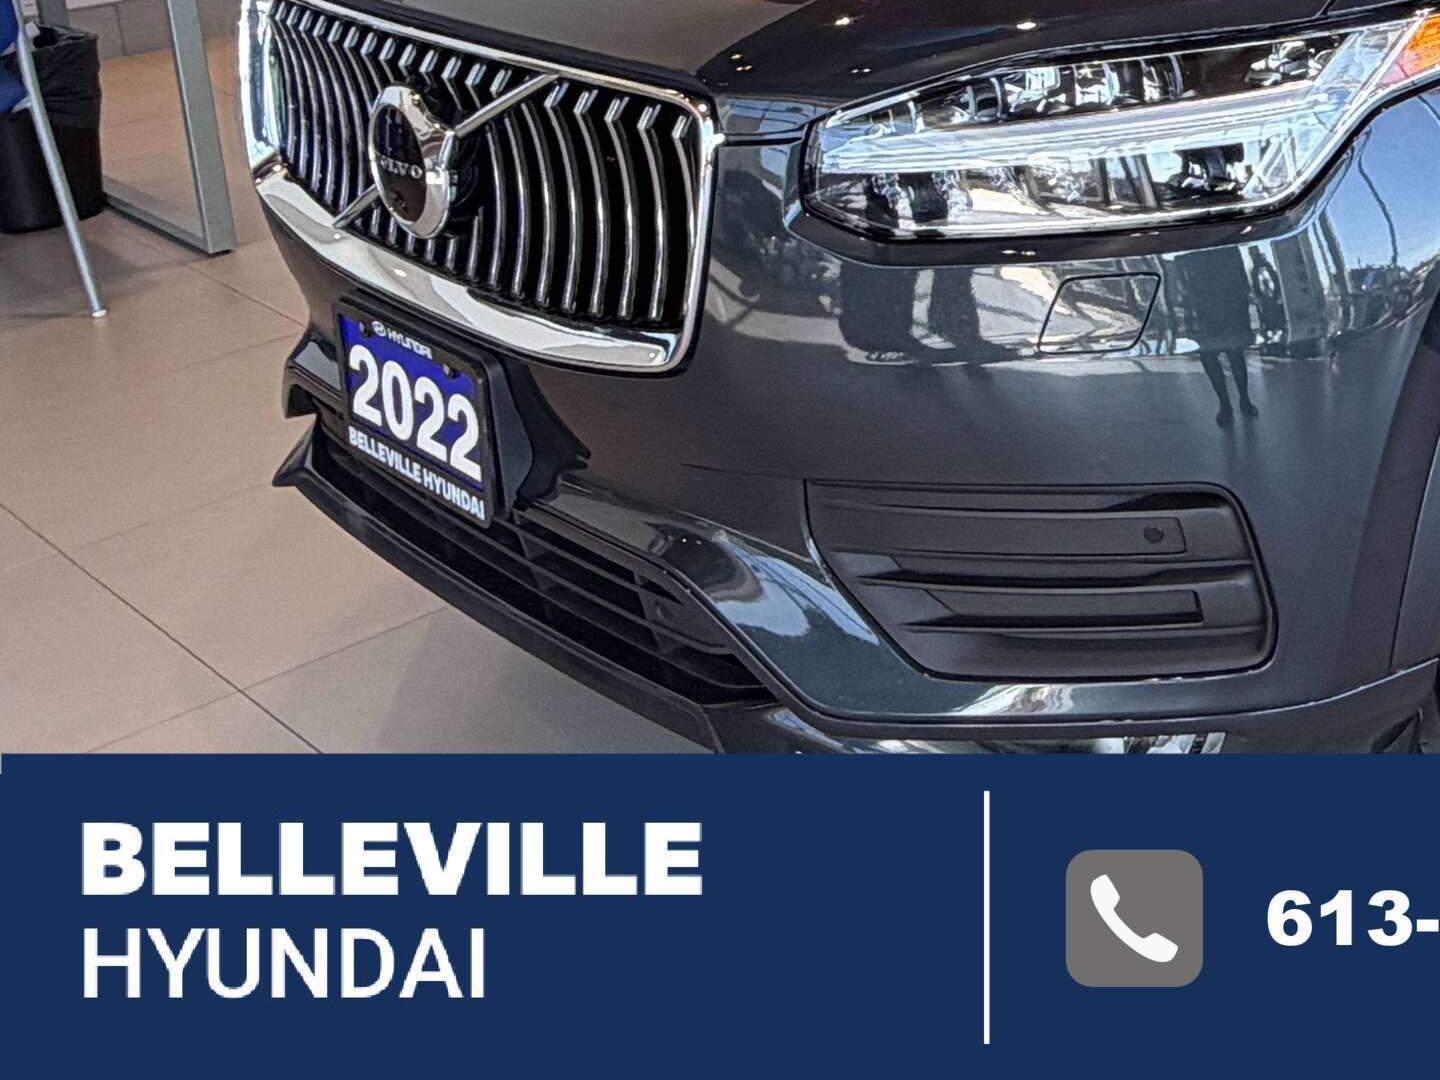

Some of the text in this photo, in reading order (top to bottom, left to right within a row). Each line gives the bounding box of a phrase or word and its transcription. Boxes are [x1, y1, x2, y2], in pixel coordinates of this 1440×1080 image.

[349, 344, 482, 483] 2022
[348, 426, 485, 520] BELLEVILLE HYUNDAI
